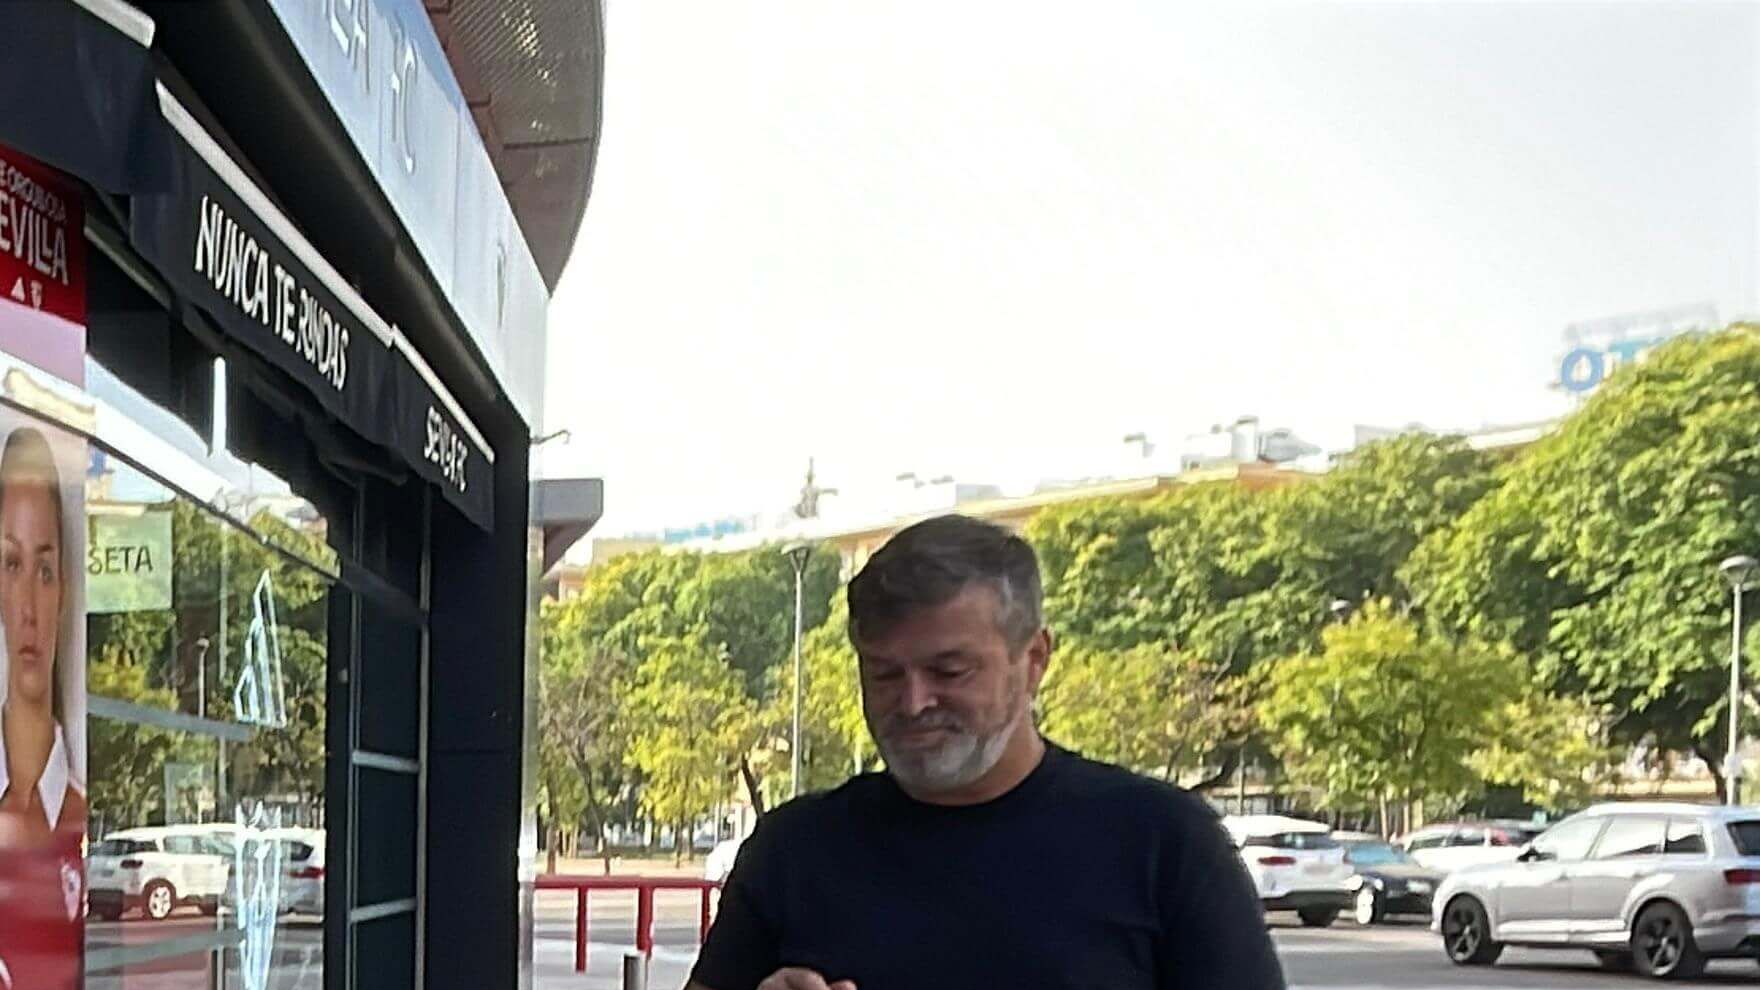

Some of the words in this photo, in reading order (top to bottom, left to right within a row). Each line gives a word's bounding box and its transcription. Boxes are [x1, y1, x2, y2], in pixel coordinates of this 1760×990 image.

[195, 195, 270, 326] NUNCA
[274, 264, 296, 346] TE
[296, 287, 349, 392] RINDAS
